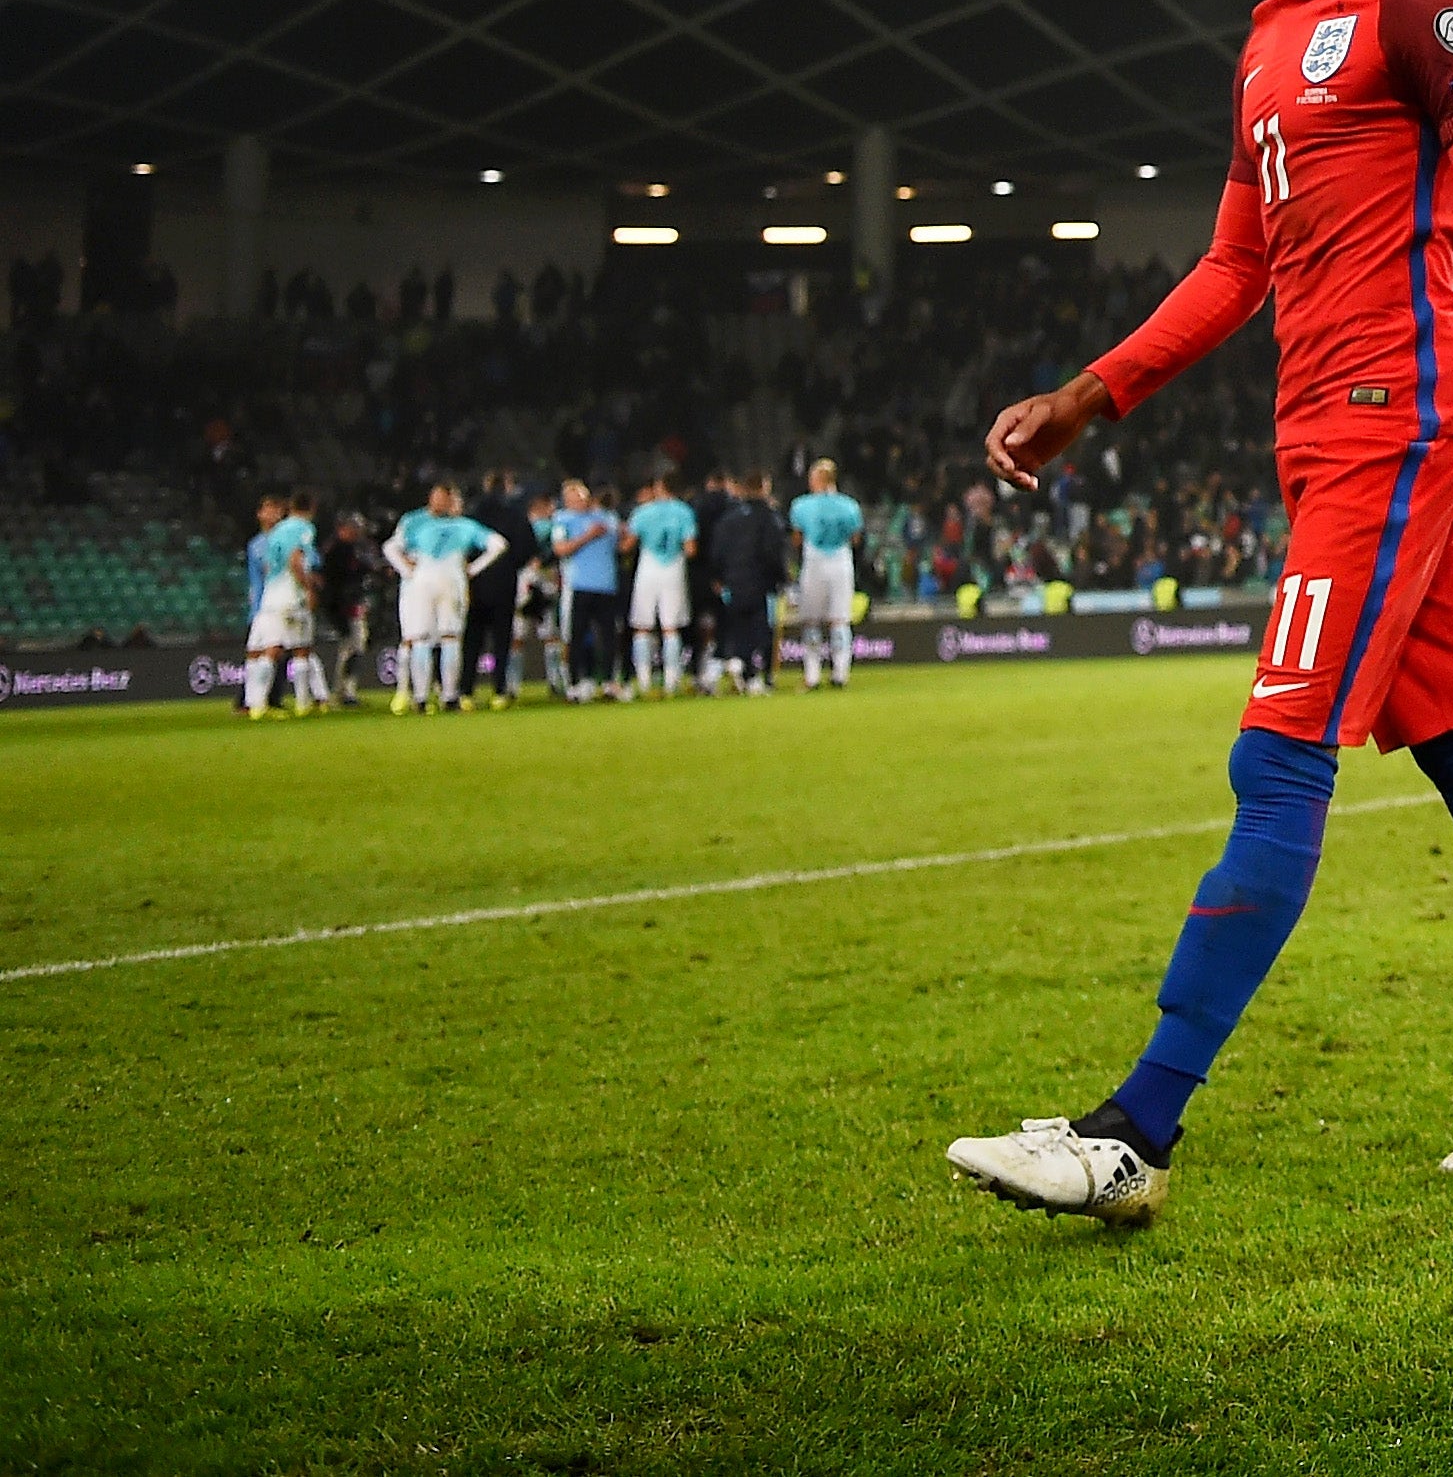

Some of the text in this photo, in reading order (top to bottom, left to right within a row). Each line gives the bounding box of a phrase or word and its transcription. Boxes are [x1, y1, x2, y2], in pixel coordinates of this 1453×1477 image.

[1252, 112, 1290, 204] 11
[1271, 573, 1334, 671] 11
[1095, 1173, 1147, 1206] adidas
